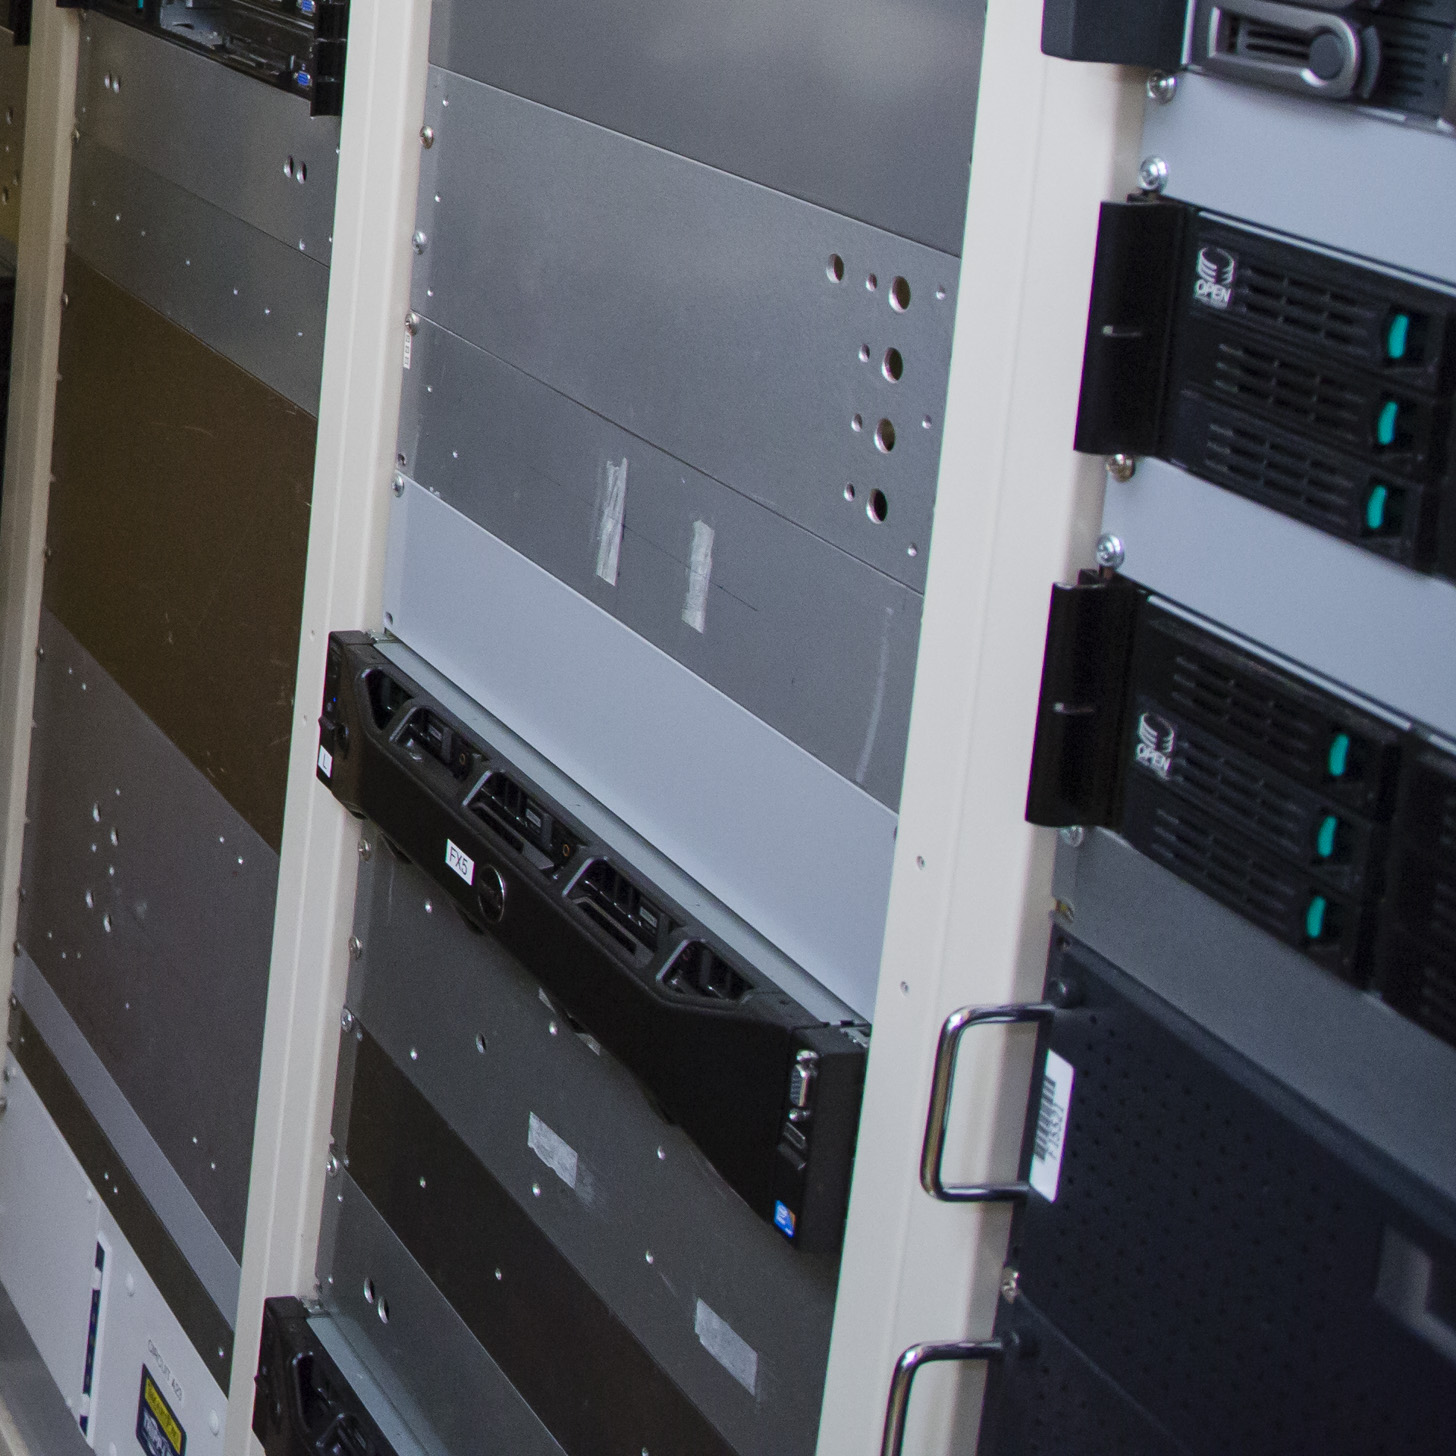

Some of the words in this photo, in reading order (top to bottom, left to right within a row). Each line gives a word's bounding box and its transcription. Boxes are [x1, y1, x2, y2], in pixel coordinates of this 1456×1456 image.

[1195, 279, 1232, 303] OPEN
[322, 754, 327, 770] L
[1136, 743, 1171, 772] OPEN
[449, 846, 469, 875] FX5
